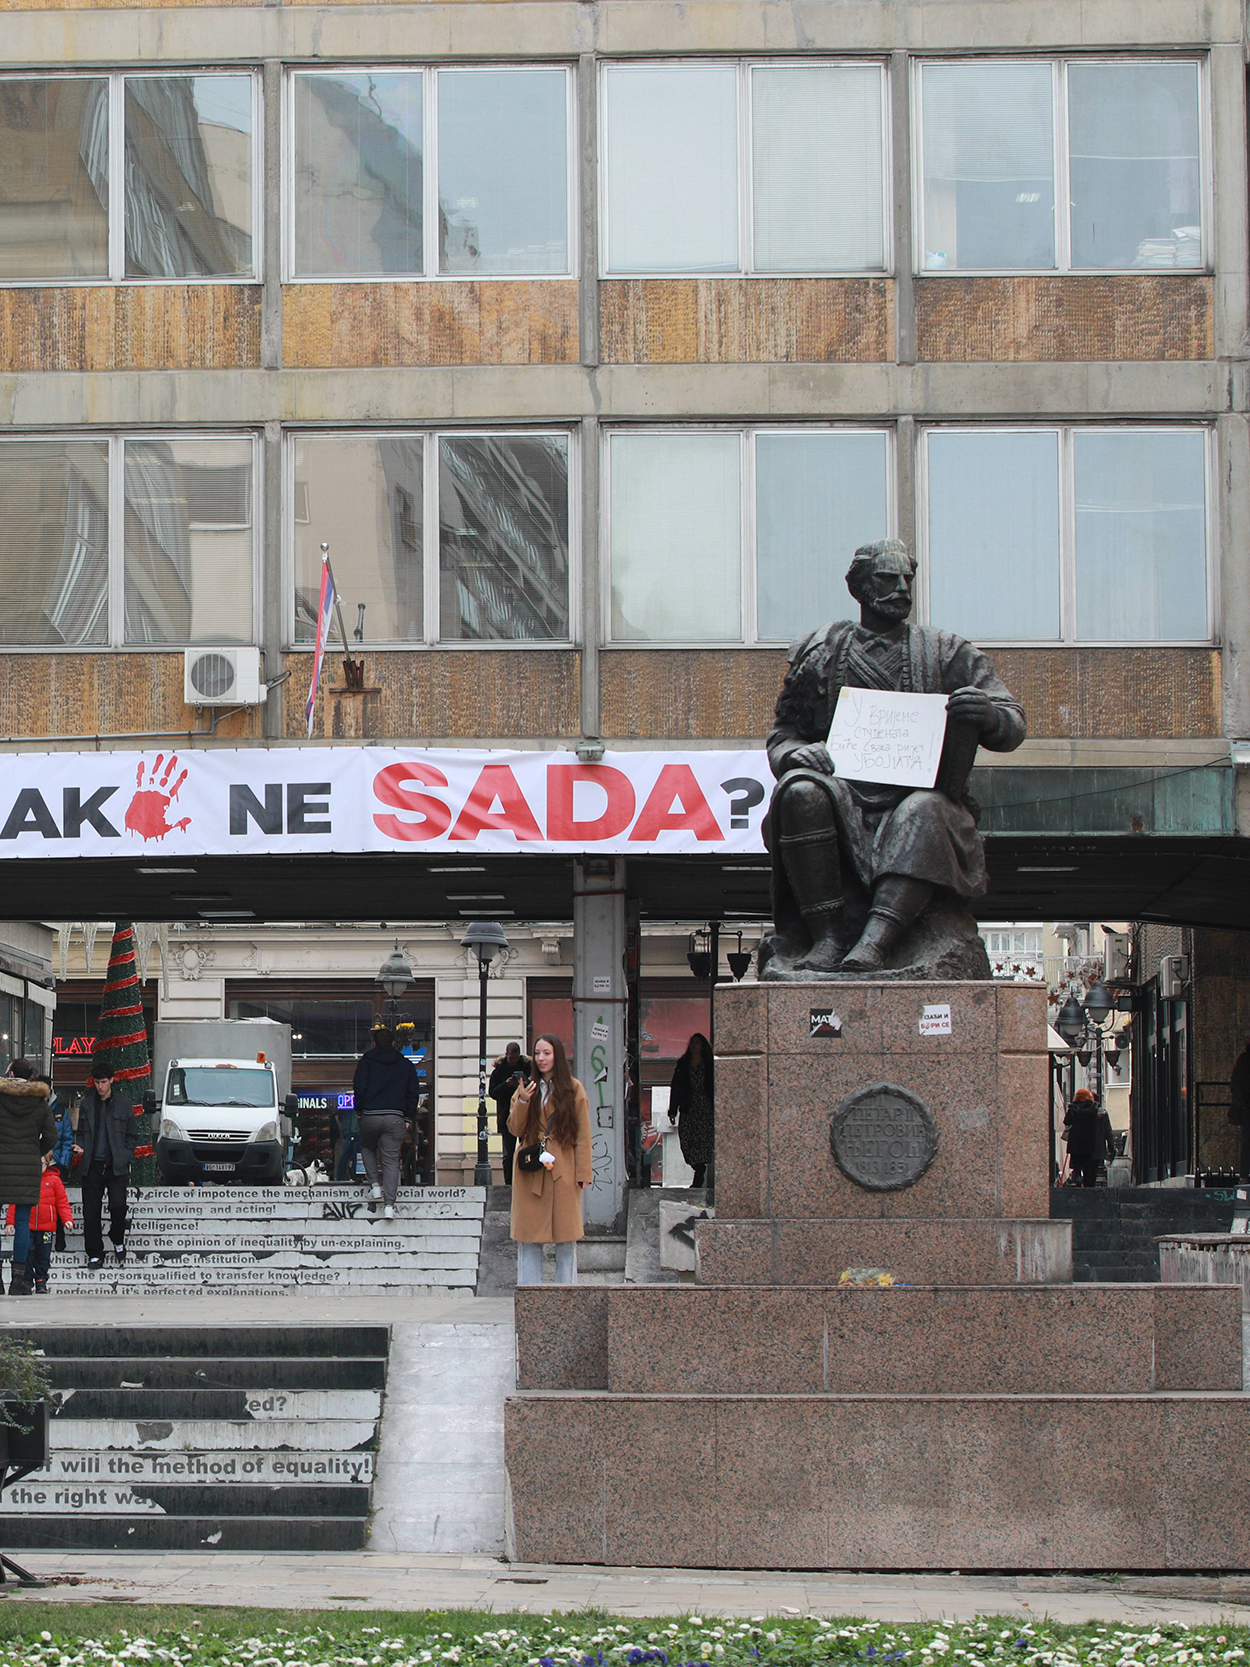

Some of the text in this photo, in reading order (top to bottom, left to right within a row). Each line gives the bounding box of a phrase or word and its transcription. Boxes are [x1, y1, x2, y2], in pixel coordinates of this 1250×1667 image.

[228, 782, 332, 836] NE
[372, 761, 766, 842] SADA?
[149, 1188, 179, 1198] circle
[183, 1188, 195, 1198] of
[198, 1189, 258, 1201] impotence
[262, 1189, 280, 1198] the
[284, 1188, 353, 1198] mechanism
[353, 1188, 364, 1198] of
[396, 1188, 424, 1198] ocial
[427, 1188, 466, 1198] world?
[158, 1205, 203, 1215] viewing
[210, 1205, 231, 1214] and
[235, 1205, 276, 1215] acting!
[130, 1221, 199, 1232] ntelligence!
[154, 1237, 173, 1246] the
[177, 1238, 220, 1249] opinion
[224, 1237, 236, 1246] of
[240, 1237, 299, 1249] inequality
[303, 1238, 317, 1249] by
[321, 1238, 405, 1249] un-explaining.
[62, 1270, 72, 1280] is
[76, 1270, 95, 1280] the
[143, 1271, 196, 1282] qualified
[200, 1272, 212, 1280] to
[216, 1271, 264, 1280] transfer
[268, 1272, 340, 1283] knowledge?
[248, 1396, 287, 1411] ed?
[61, 1457, 100, 1473] will
[108, 1457, 144, 1474] the
[152, 1458, 236, 1475] method
[242, 1457, 264, 1474] of
[272, 1457, 369, 1478] equality!
[10, 1488, 47, 1504] the
[54, 1488, 107, 1508] right
